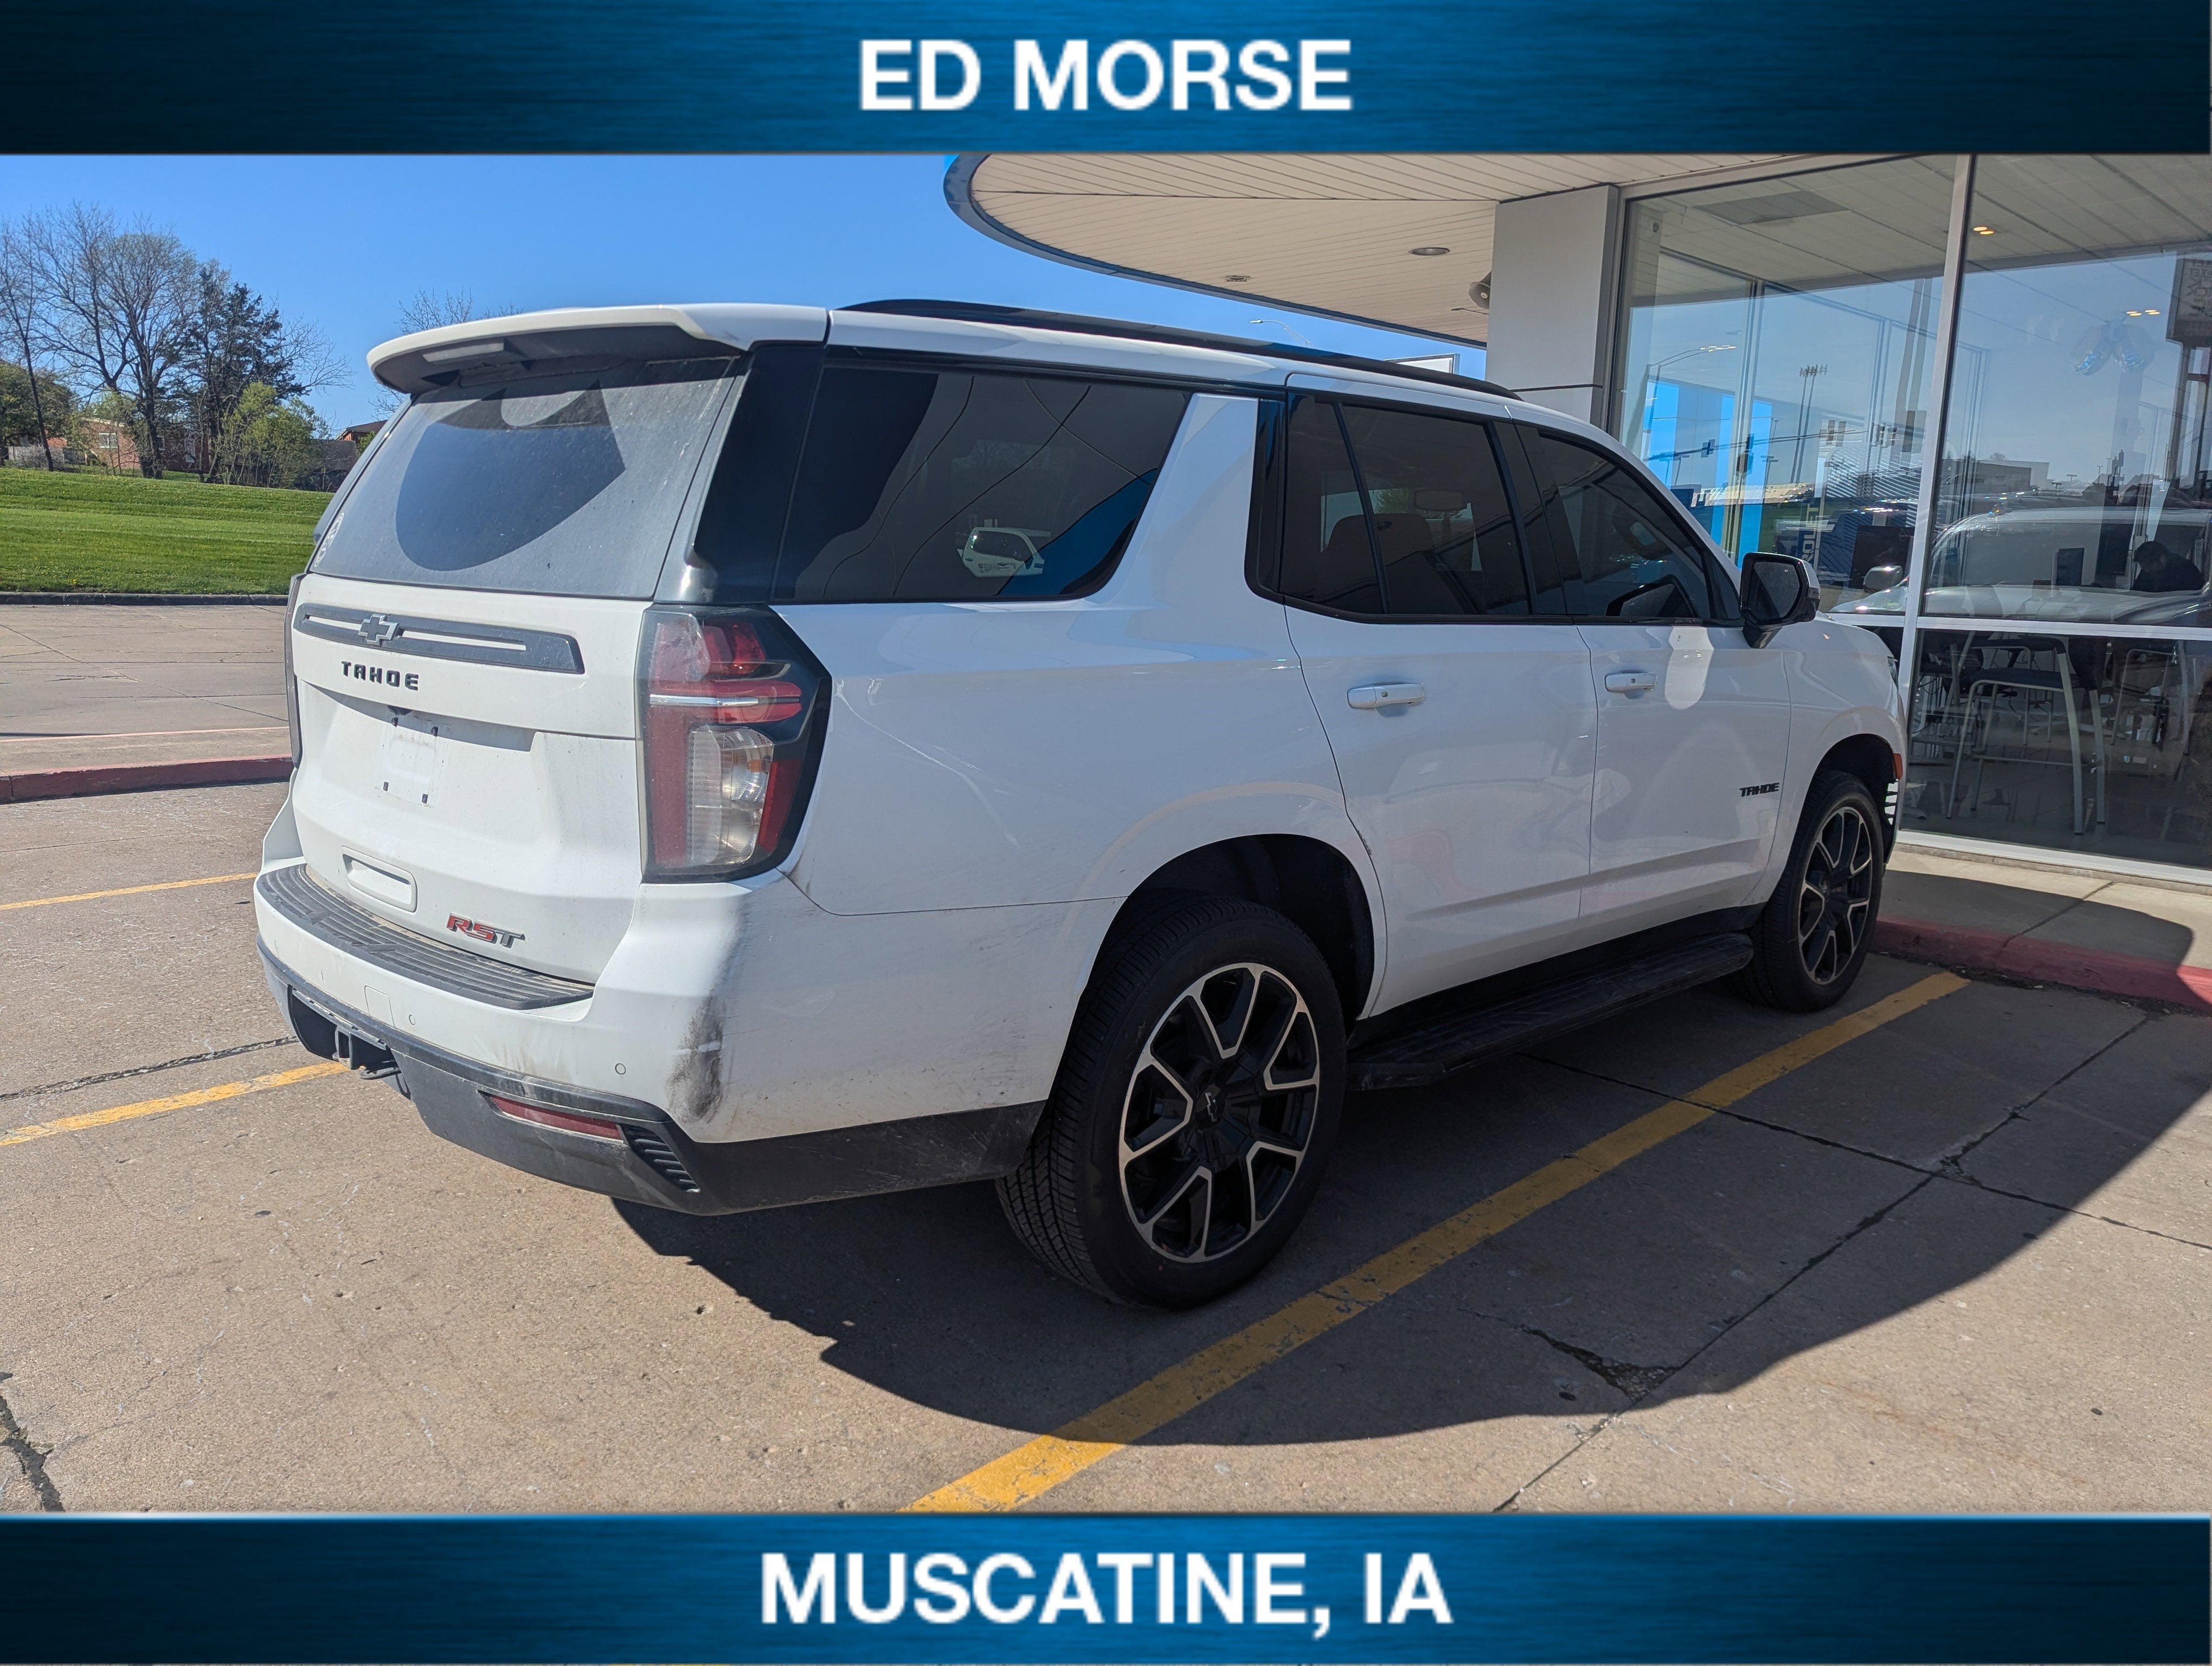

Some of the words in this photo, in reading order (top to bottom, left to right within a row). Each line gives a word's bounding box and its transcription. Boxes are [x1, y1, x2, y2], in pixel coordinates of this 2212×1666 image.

[341, 660, 420, 691] TAHOE
[1739, 782, 1780, 797] TAHOE
[446, 911, 526, 949] RST
